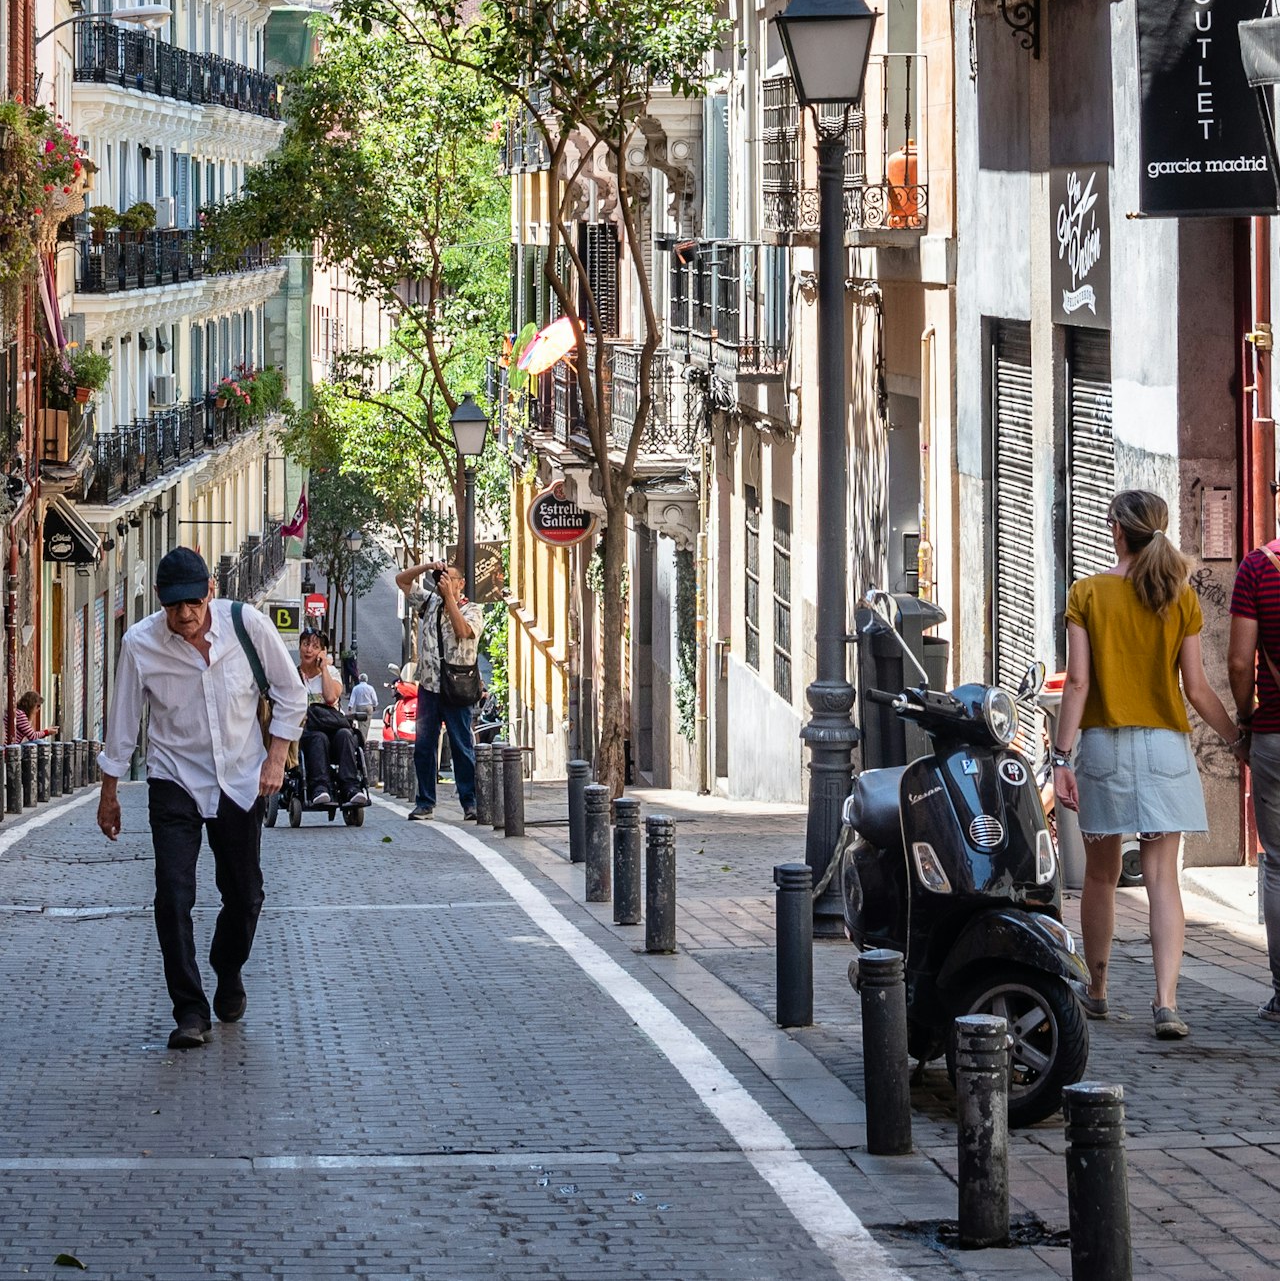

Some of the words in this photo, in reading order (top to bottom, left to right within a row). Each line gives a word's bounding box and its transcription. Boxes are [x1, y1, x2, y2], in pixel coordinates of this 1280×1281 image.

[1147, 158, 1201, 178] garcia
[1205, 155, 1268, 173] madrid
[540, 502, 584, 515] Estrella
[541, 515, 582, 527] Galicia
[277, 609, 291, 627] B
[908, 785, 943, 805] Vespa
